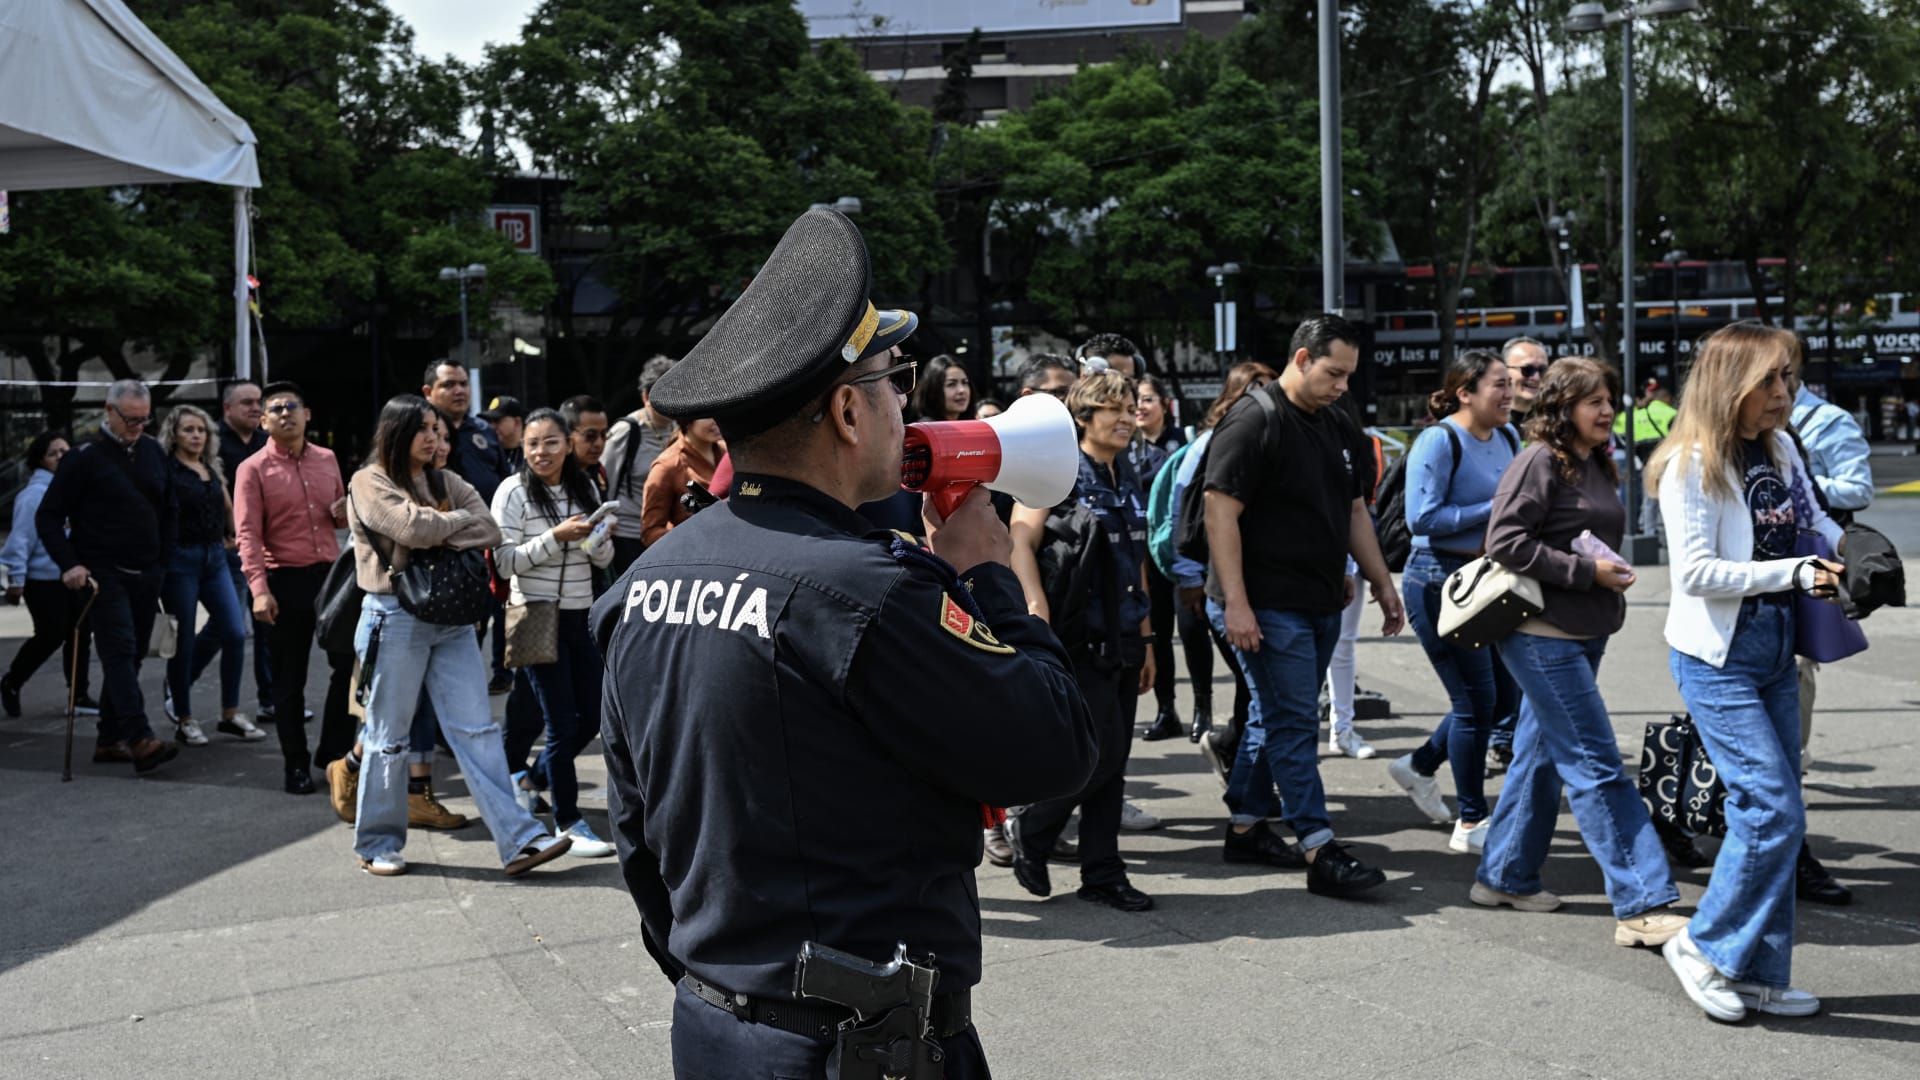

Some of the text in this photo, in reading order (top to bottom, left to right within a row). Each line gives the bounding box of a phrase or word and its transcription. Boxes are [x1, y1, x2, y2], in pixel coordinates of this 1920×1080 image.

[1374, 349, 1397, 368] oy,
[1400, 346, 1426, 363] las
[1872, 332, 1920, 348] voce
[623, 572, 771, 639] POLICÍA
